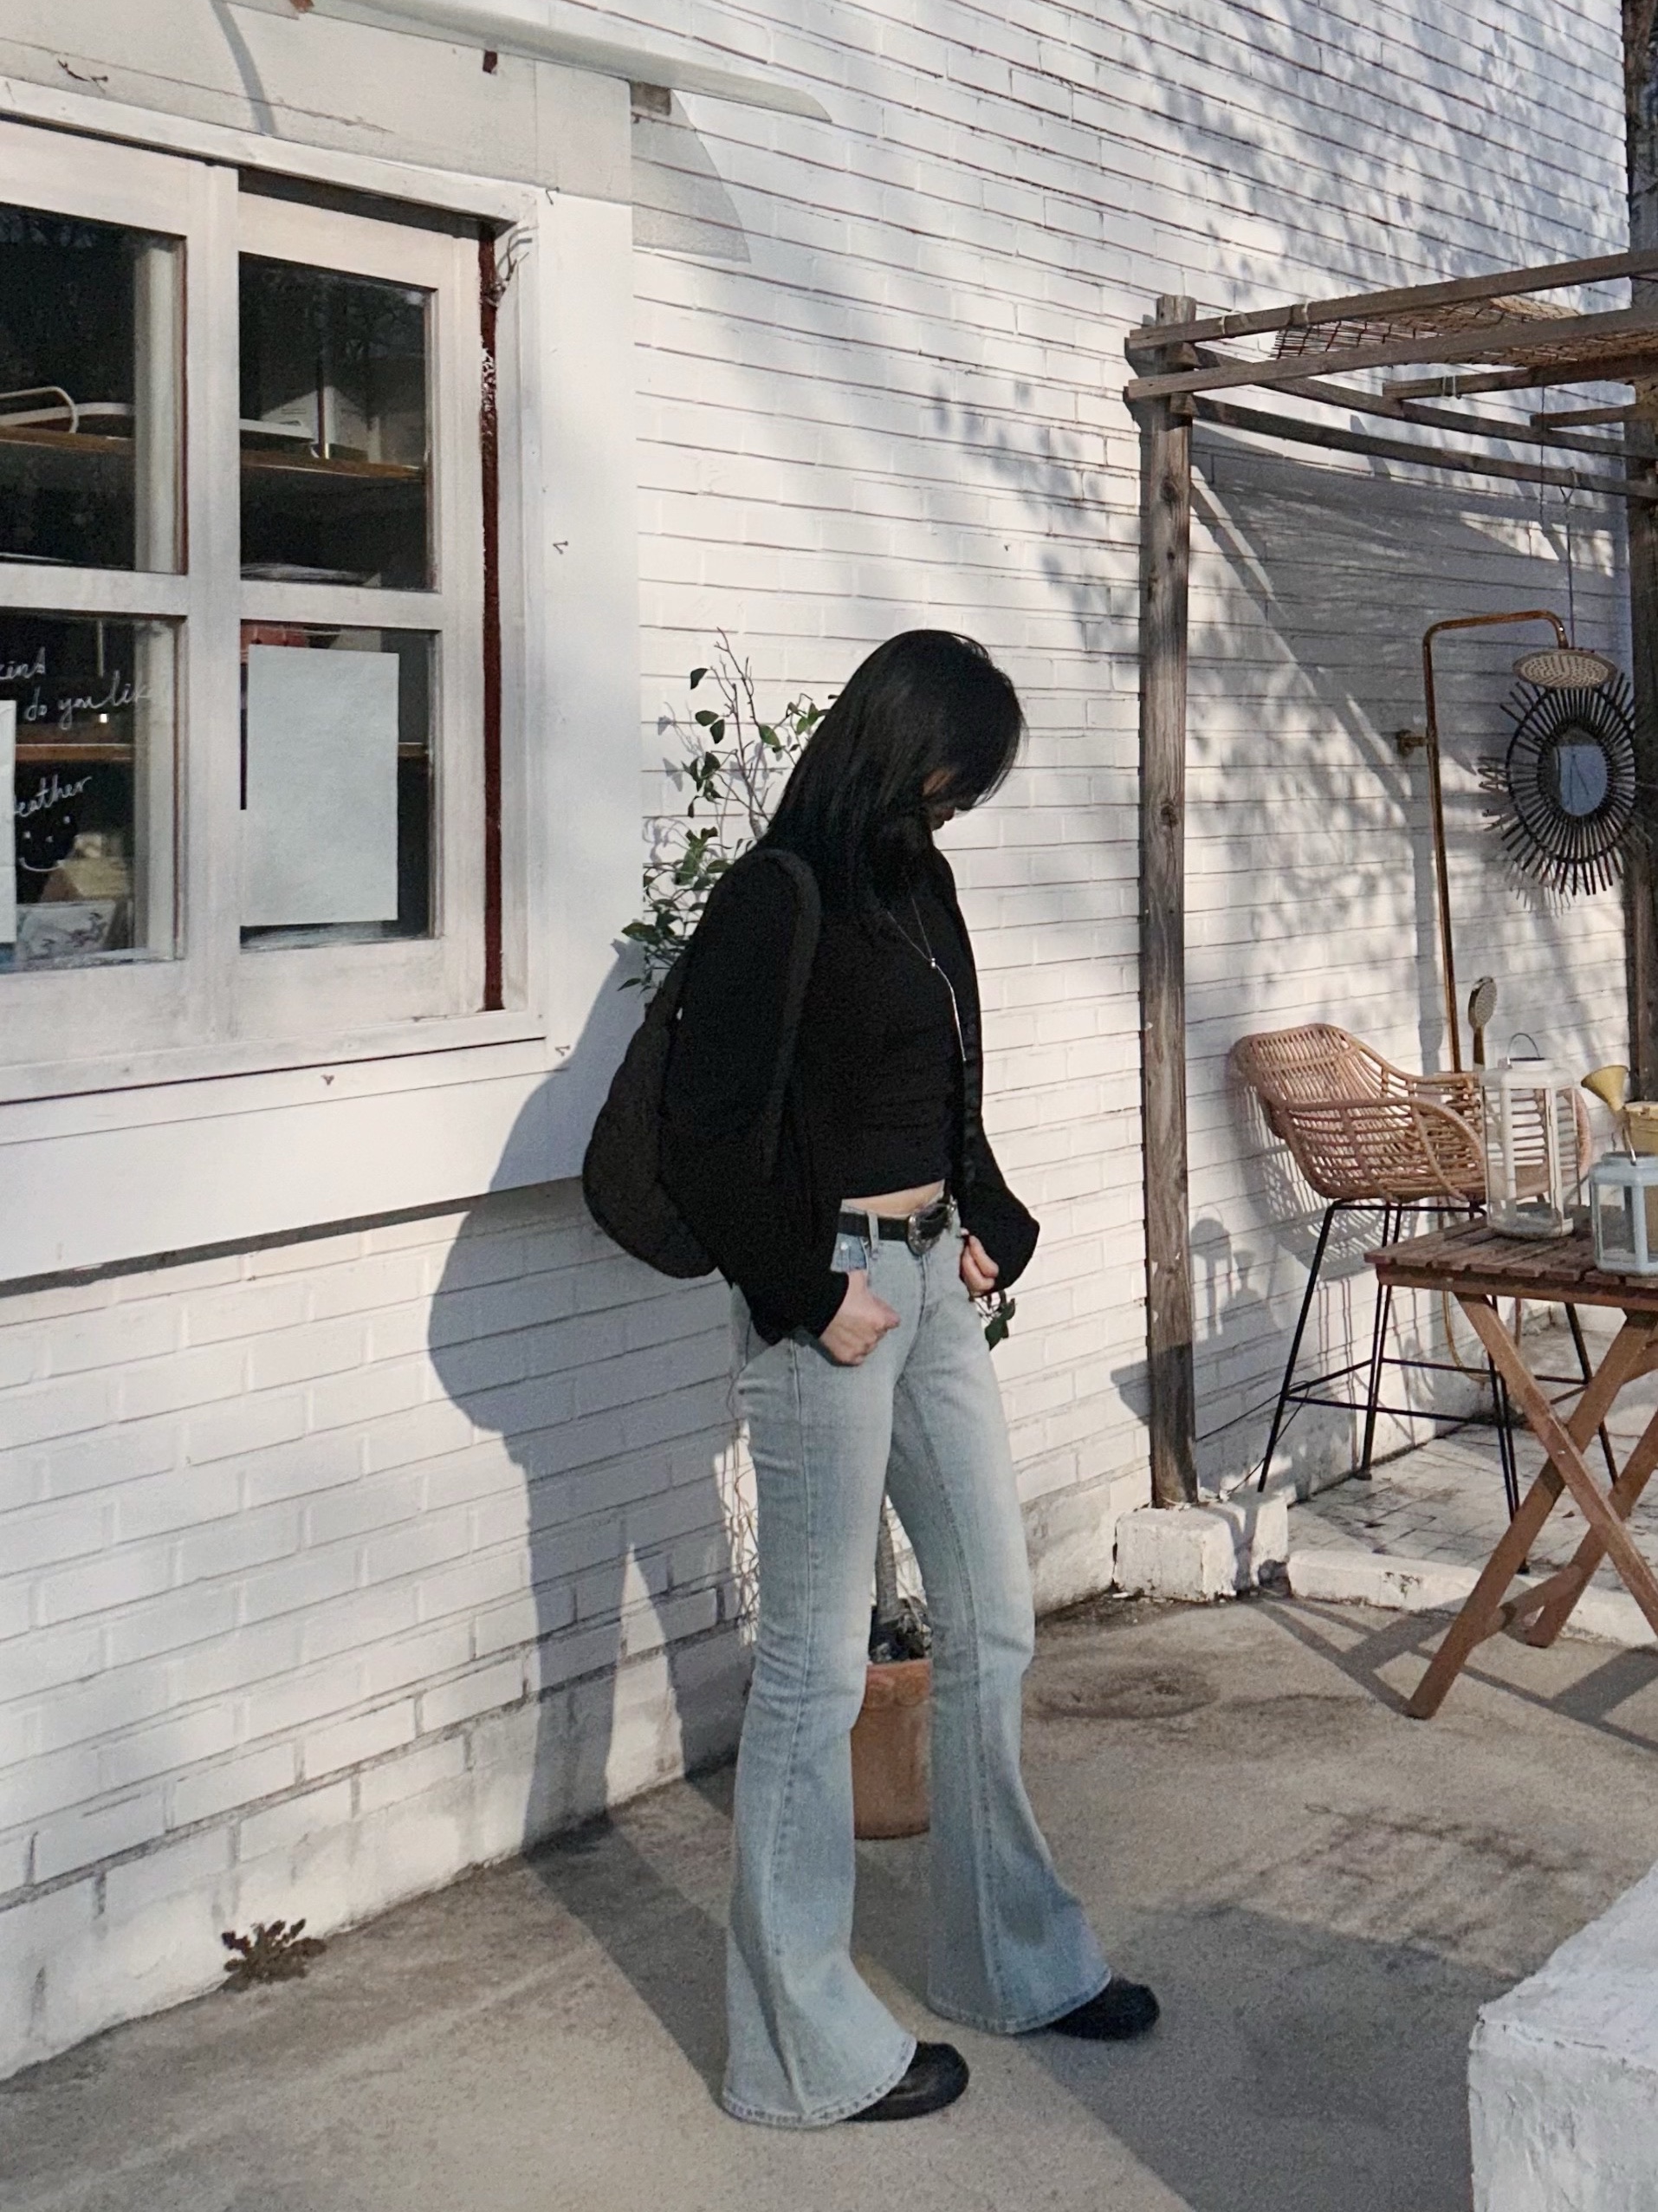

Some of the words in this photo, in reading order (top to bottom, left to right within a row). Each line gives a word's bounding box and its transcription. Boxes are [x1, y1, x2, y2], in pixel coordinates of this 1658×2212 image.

[24, 685, 48, 721] do
[57, 696, 100, 730] you
[14, 774, 93, 817] eather
